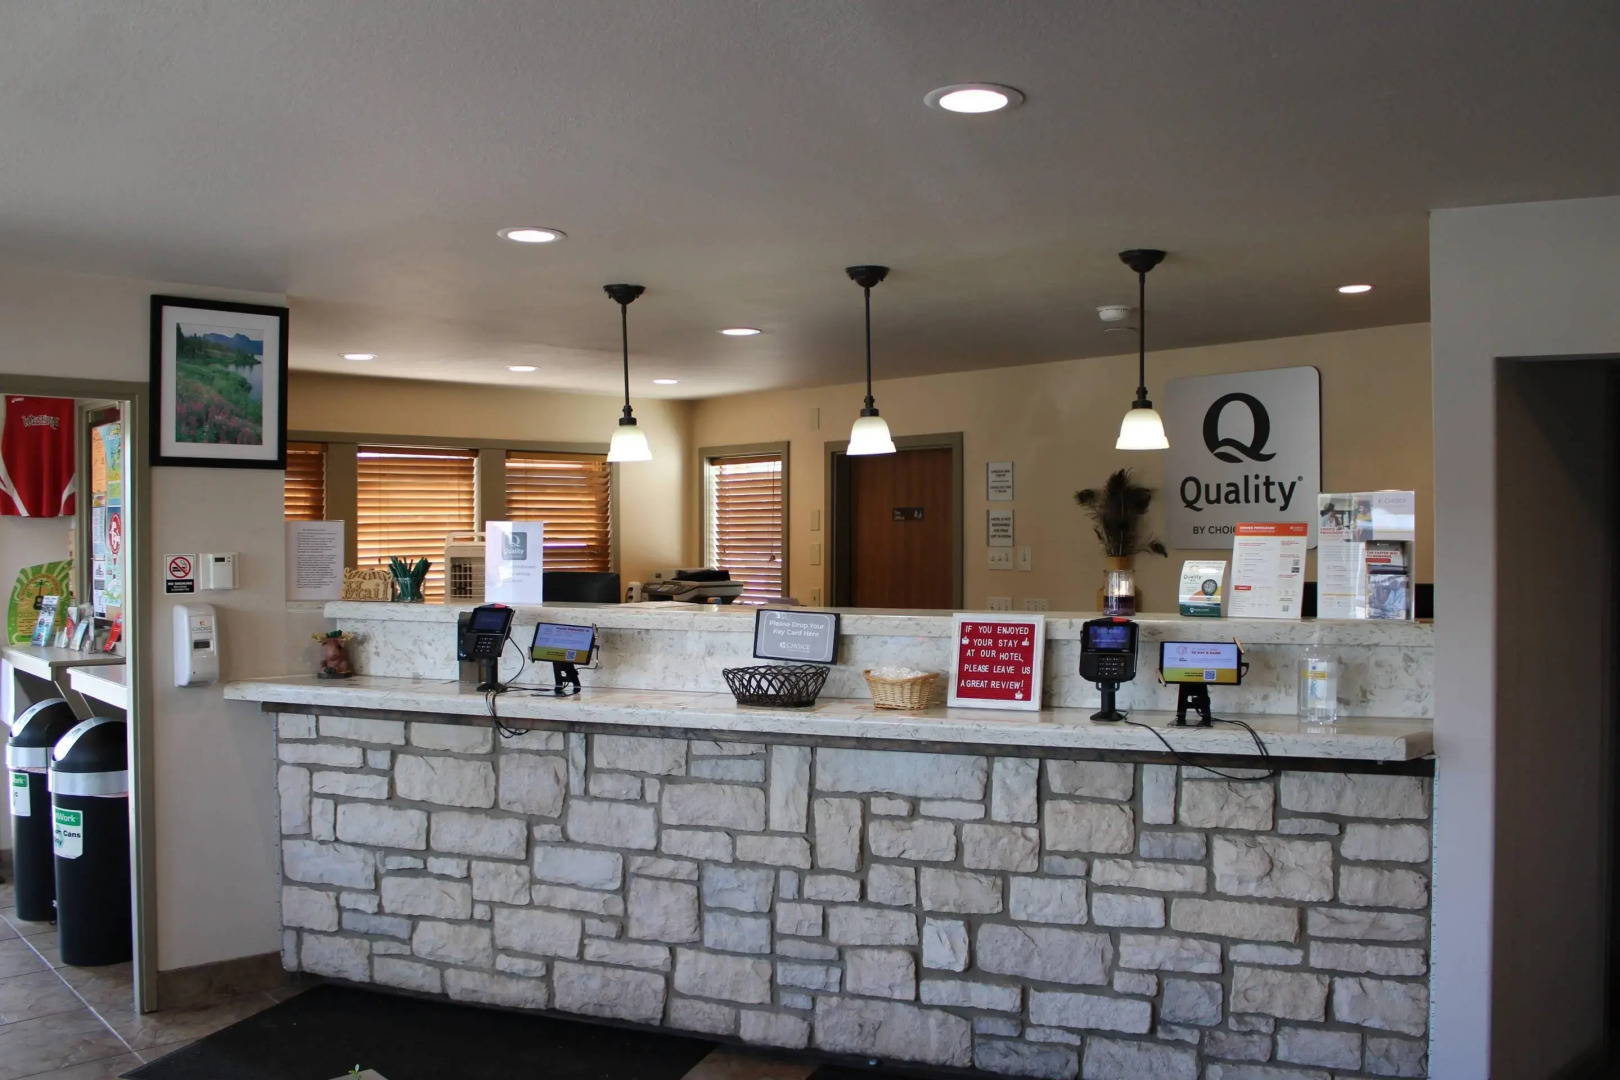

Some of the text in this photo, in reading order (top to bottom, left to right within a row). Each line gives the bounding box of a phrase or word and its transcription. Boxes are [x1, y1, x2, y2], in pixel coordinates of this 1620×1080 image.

[1203, 392, 1276, 463] Q
[1180, 474, 1297, 512] Quality
[1193, 526, 1205, 534] BY
[792, 621, 808, 629] Drop
[773, 628, 785, 636] Key
[965, 625, 1029, 635] IF YOU ENJOYED
[973, 639, 993, 647] YOUR
[966, 649, 975, 657] AT
[980, 650, 996, 658] OUR
[964, 664, 1031, 675] PLEASE LEAVE US
[966, 680, 988, 688] GREAT
[990, 680, 1024, 691] REVIEW!
[63, 830, 81, 838] Cans
